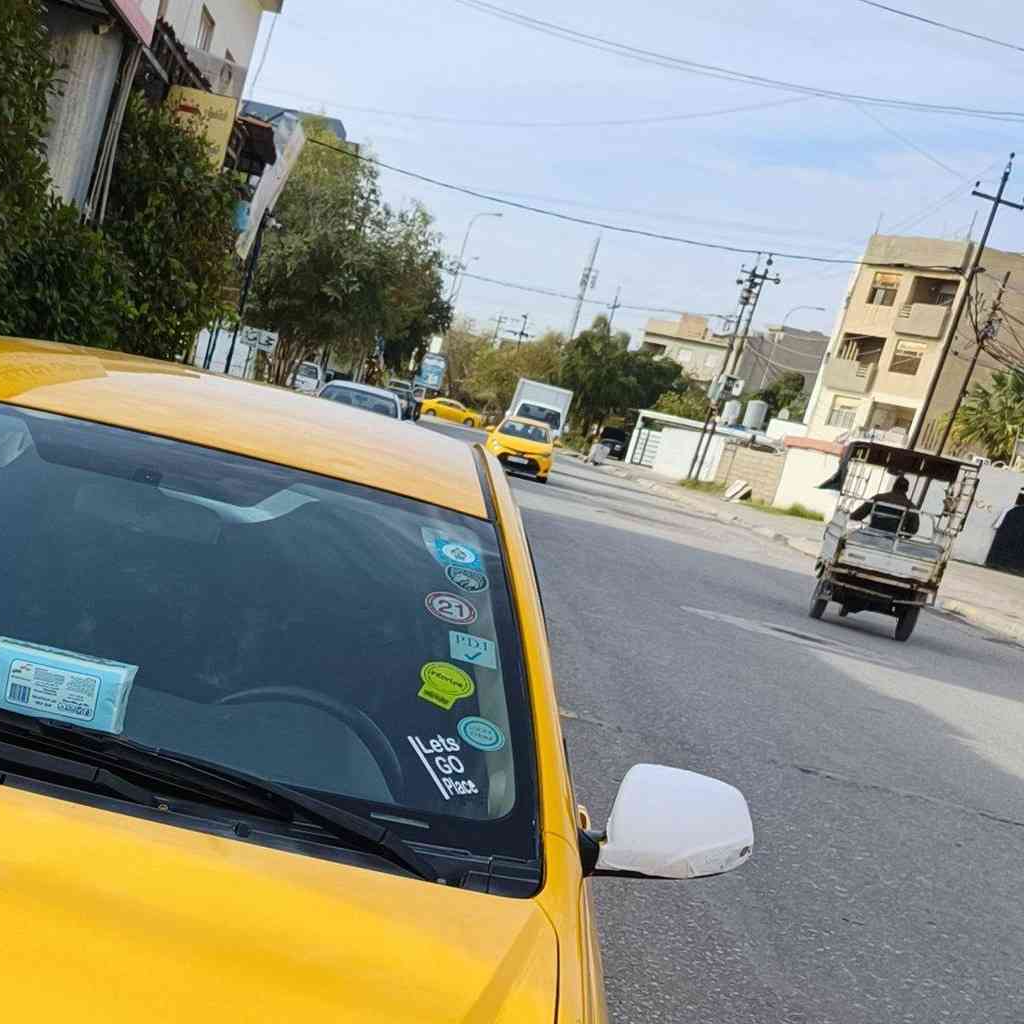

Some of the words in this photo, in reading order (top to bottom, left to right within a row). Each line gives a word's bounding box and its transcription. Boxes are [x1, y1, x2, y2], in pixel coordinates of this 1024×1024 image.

[437, 599, 464, 618] 21
[414, 733, 461, 754] Lets
[435, 755, 465, 775] GO
[442, 777, 479, 796] Place
